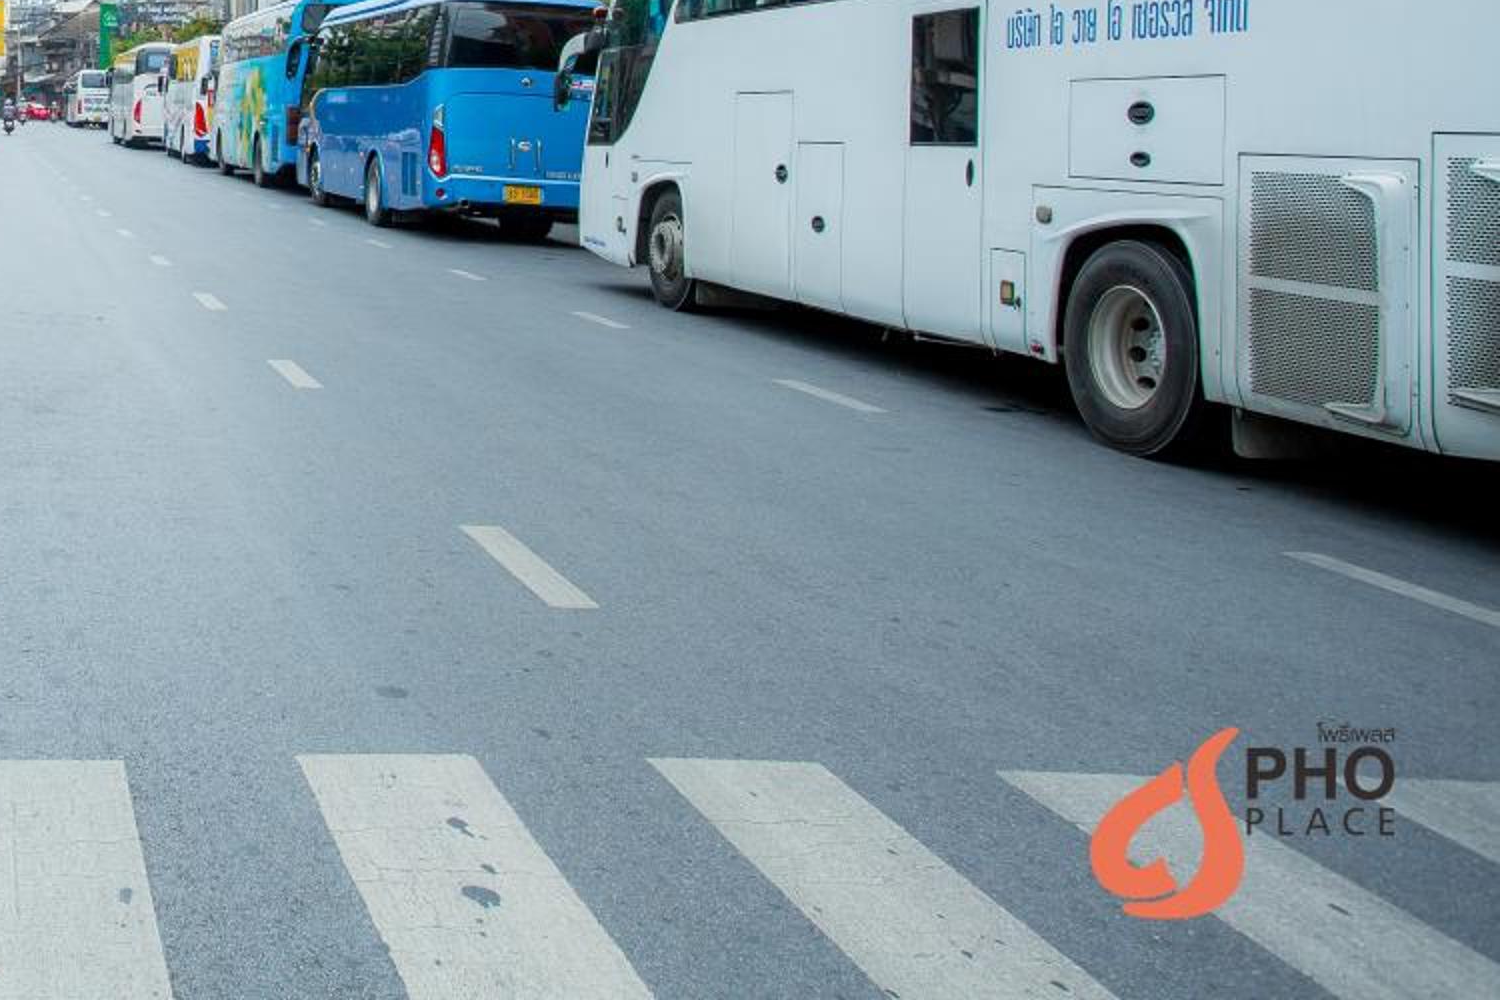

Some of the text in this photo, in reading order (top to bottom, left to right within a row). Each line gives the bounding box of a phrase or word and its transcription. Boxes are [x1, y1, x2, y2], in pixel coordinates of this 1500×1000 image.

[1006, 7, 1041, 49] บริษัท
[1071, 6, 1097, 44] วาย
